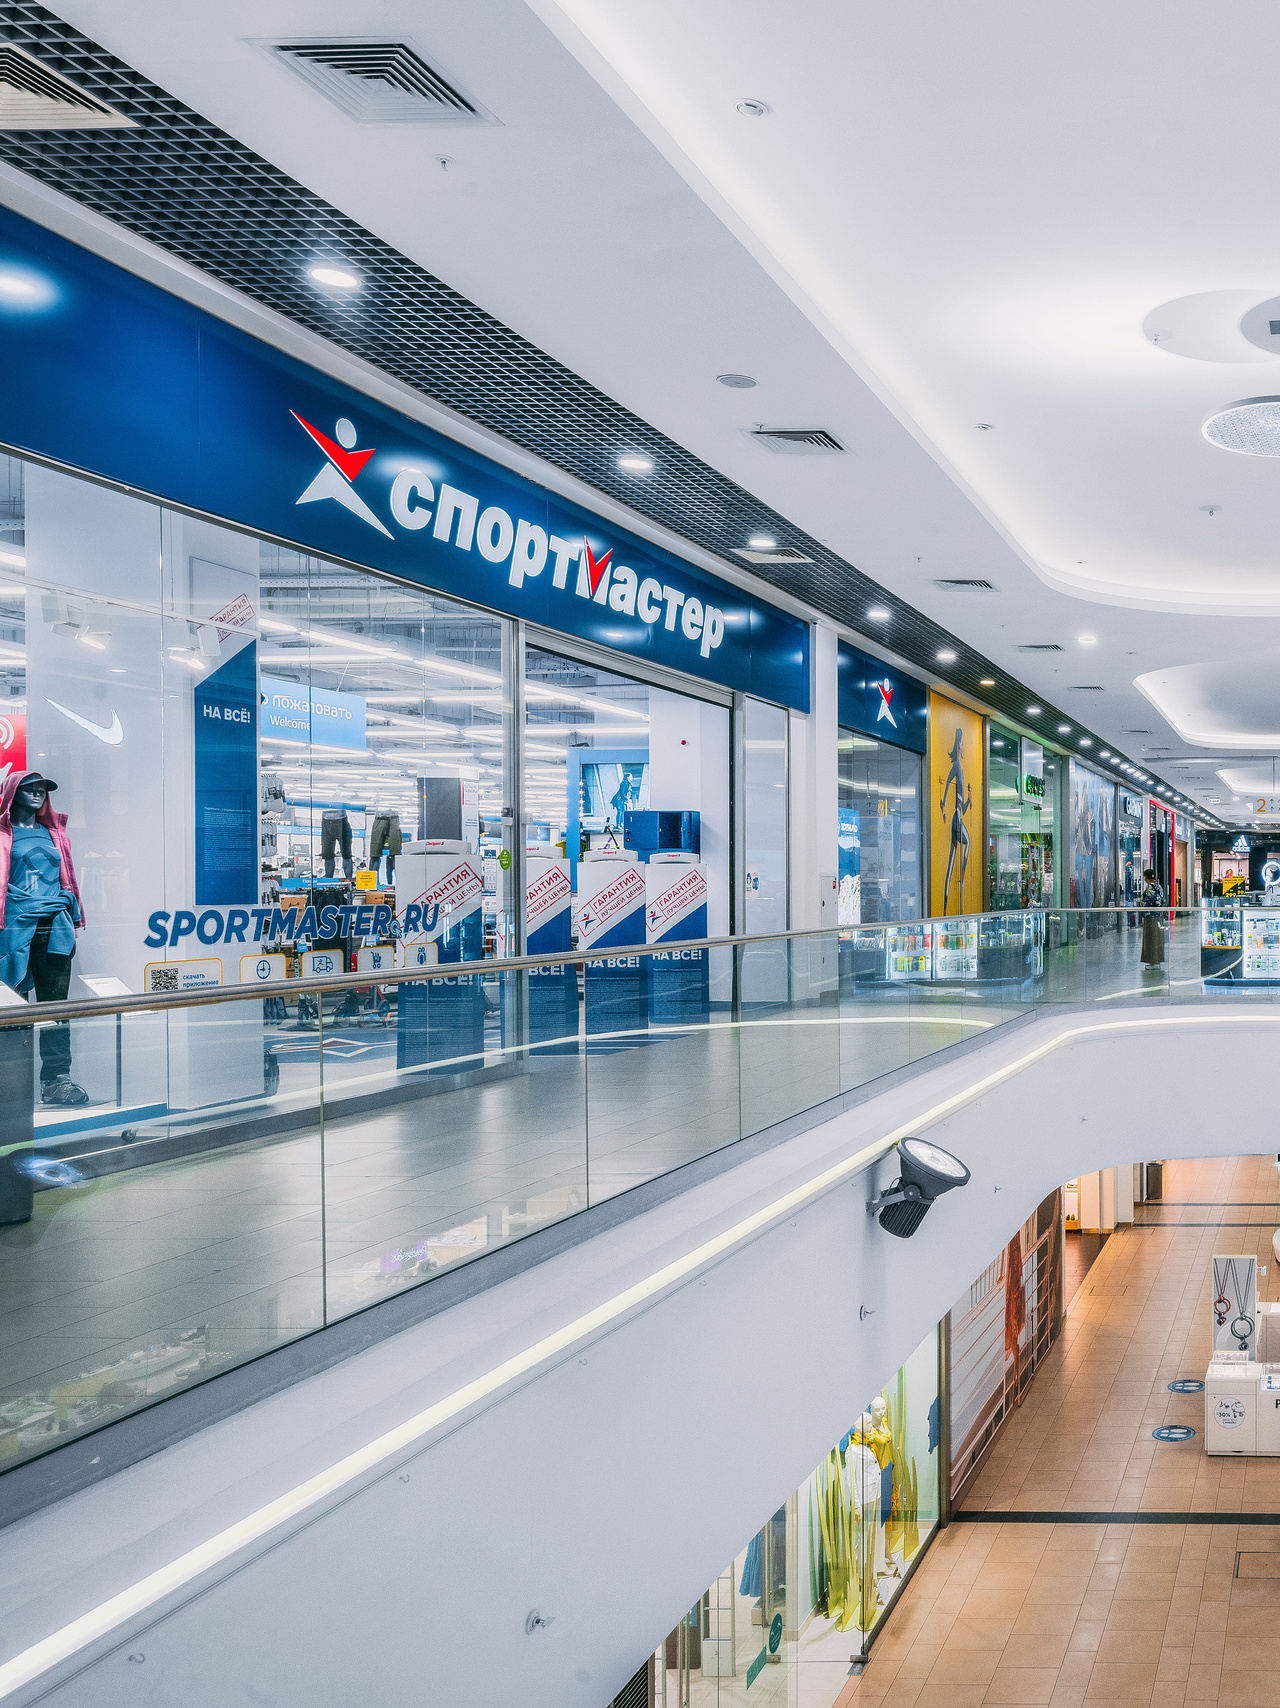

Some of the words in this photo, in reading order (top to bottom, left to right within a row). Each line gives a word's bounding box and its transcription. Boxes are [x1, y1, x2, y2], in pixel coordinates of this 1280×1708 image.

[203, 704, 222, 720] НА
[224, 707, 251, 724] ВСЁ!
[269, 714, 311, 731] Welcome
[1256, 798, 1267, 813] 2
[1232, 845, 1250, 853] adidas
[445, 881, 480, 902] ЦЕНЫ
[548, 882, 570, 901] ЦЕНЫ
[592, 872, 638, 910] ГАРАНТИЯ
[658, 873, 699, 908] ГАРАНТИЯ
[666, 894, 690, 916] ЛУЧШЕЙ
[687, 883, 705, 900] ЦЕНЫ
[600, 895, 626, 918] ЛУЧШЕЙ
[623, 883, 644, 902] ЦЕНЫ
[652, 951, 670, 960] НА
[182, 973, 206, 981] скачать
[182, 979, 219, 989] приложение
